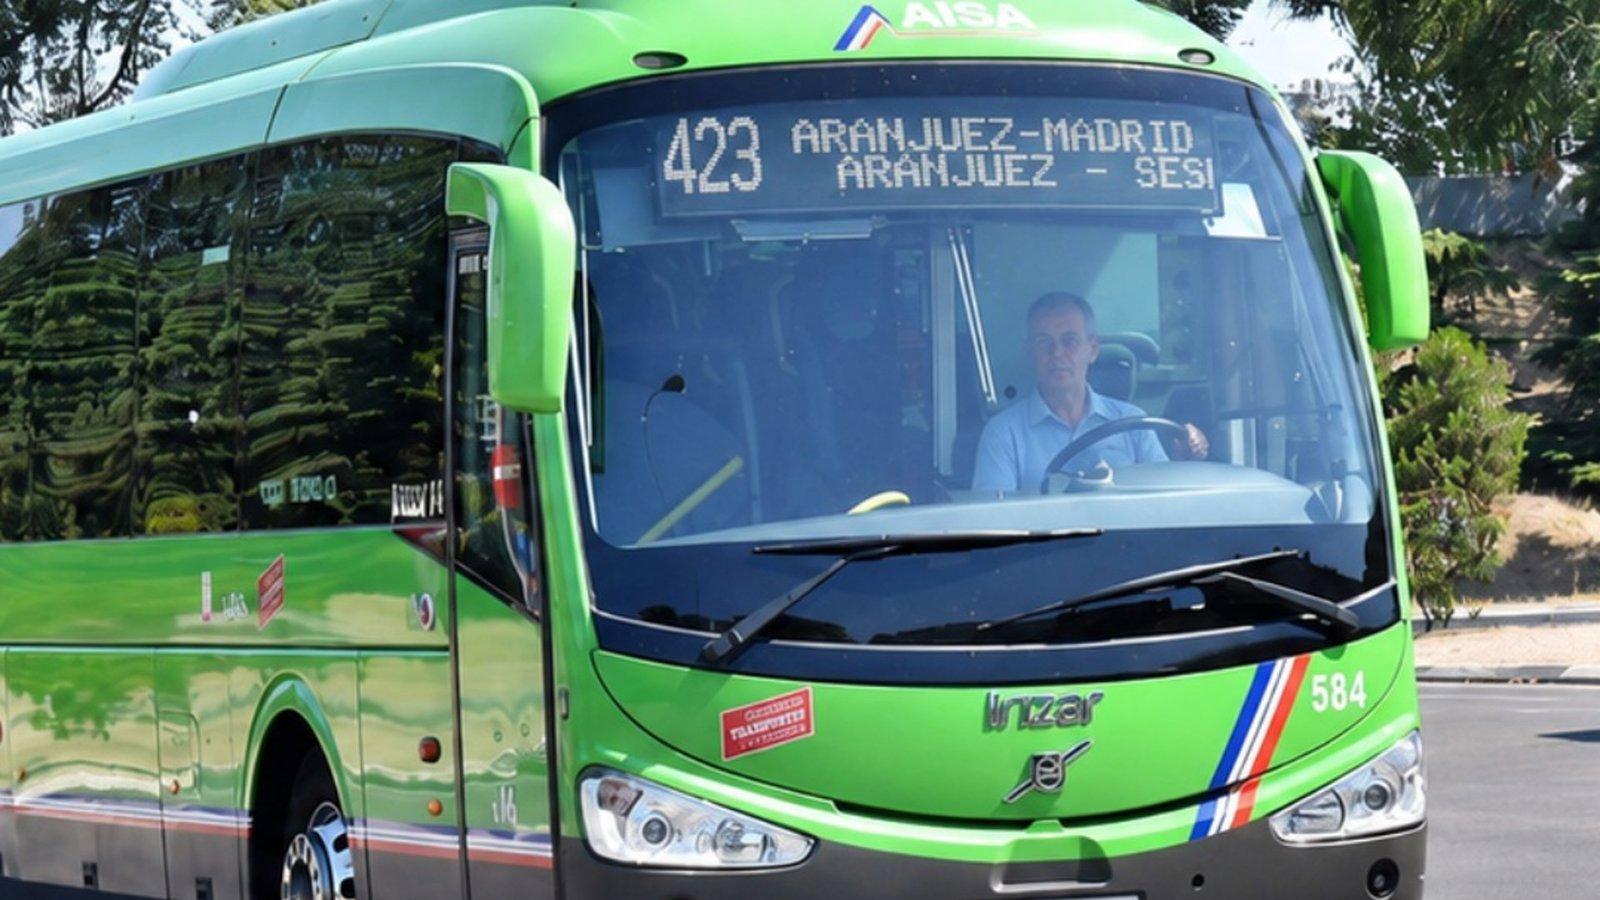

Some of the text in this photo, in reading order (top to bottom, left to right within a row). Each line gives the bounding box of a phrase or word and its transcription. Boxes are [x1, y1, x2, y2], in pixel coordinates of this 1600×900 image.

[902, 0, 1038, 29] AISA
[791, 117, 1194, 154] ARANJUEZ-MADRID
[663, 116, 763, 194] 423
[837, 154, 1057, 190] ARANJUEZ
[1311, 669, 1367, 712] 584
